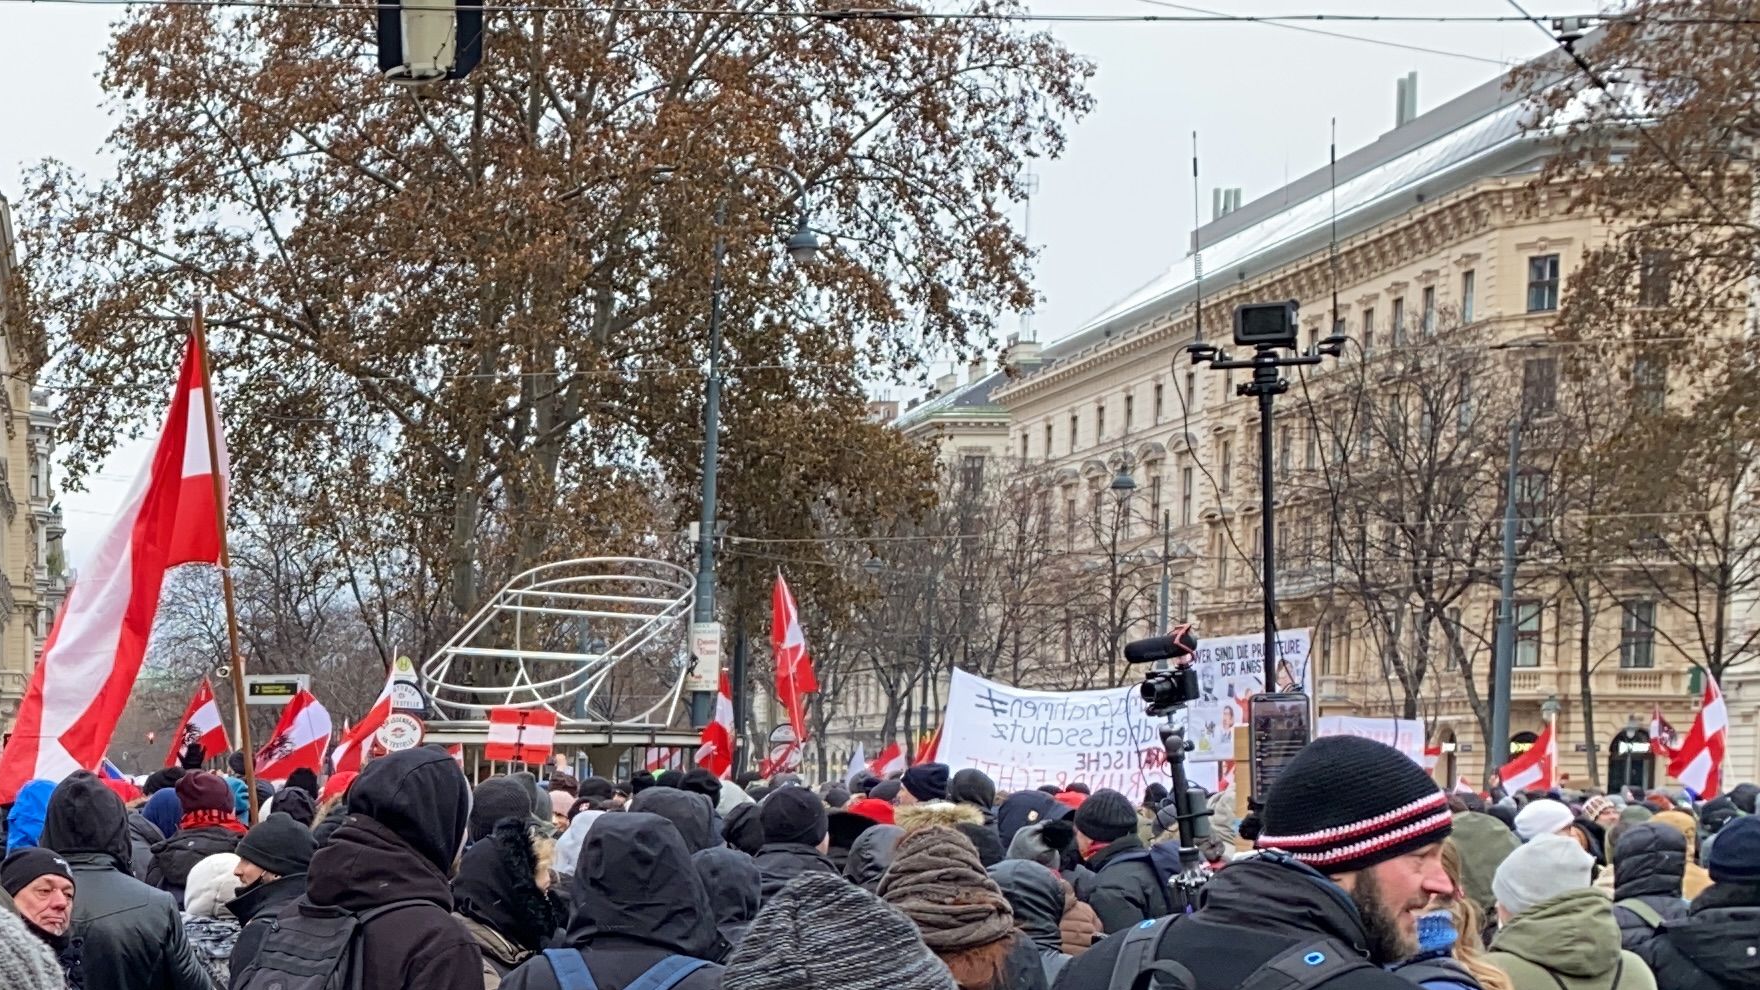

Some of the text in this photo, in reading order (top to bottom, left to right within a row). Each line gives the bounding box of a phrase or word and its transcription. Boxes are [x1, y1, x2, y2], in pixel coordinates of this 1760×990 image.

[1214, 646, 1234, 661] SIND
[1236, 644, 1249, 659] DIE
[1221, 658, 1266, 677] DER ANGS
